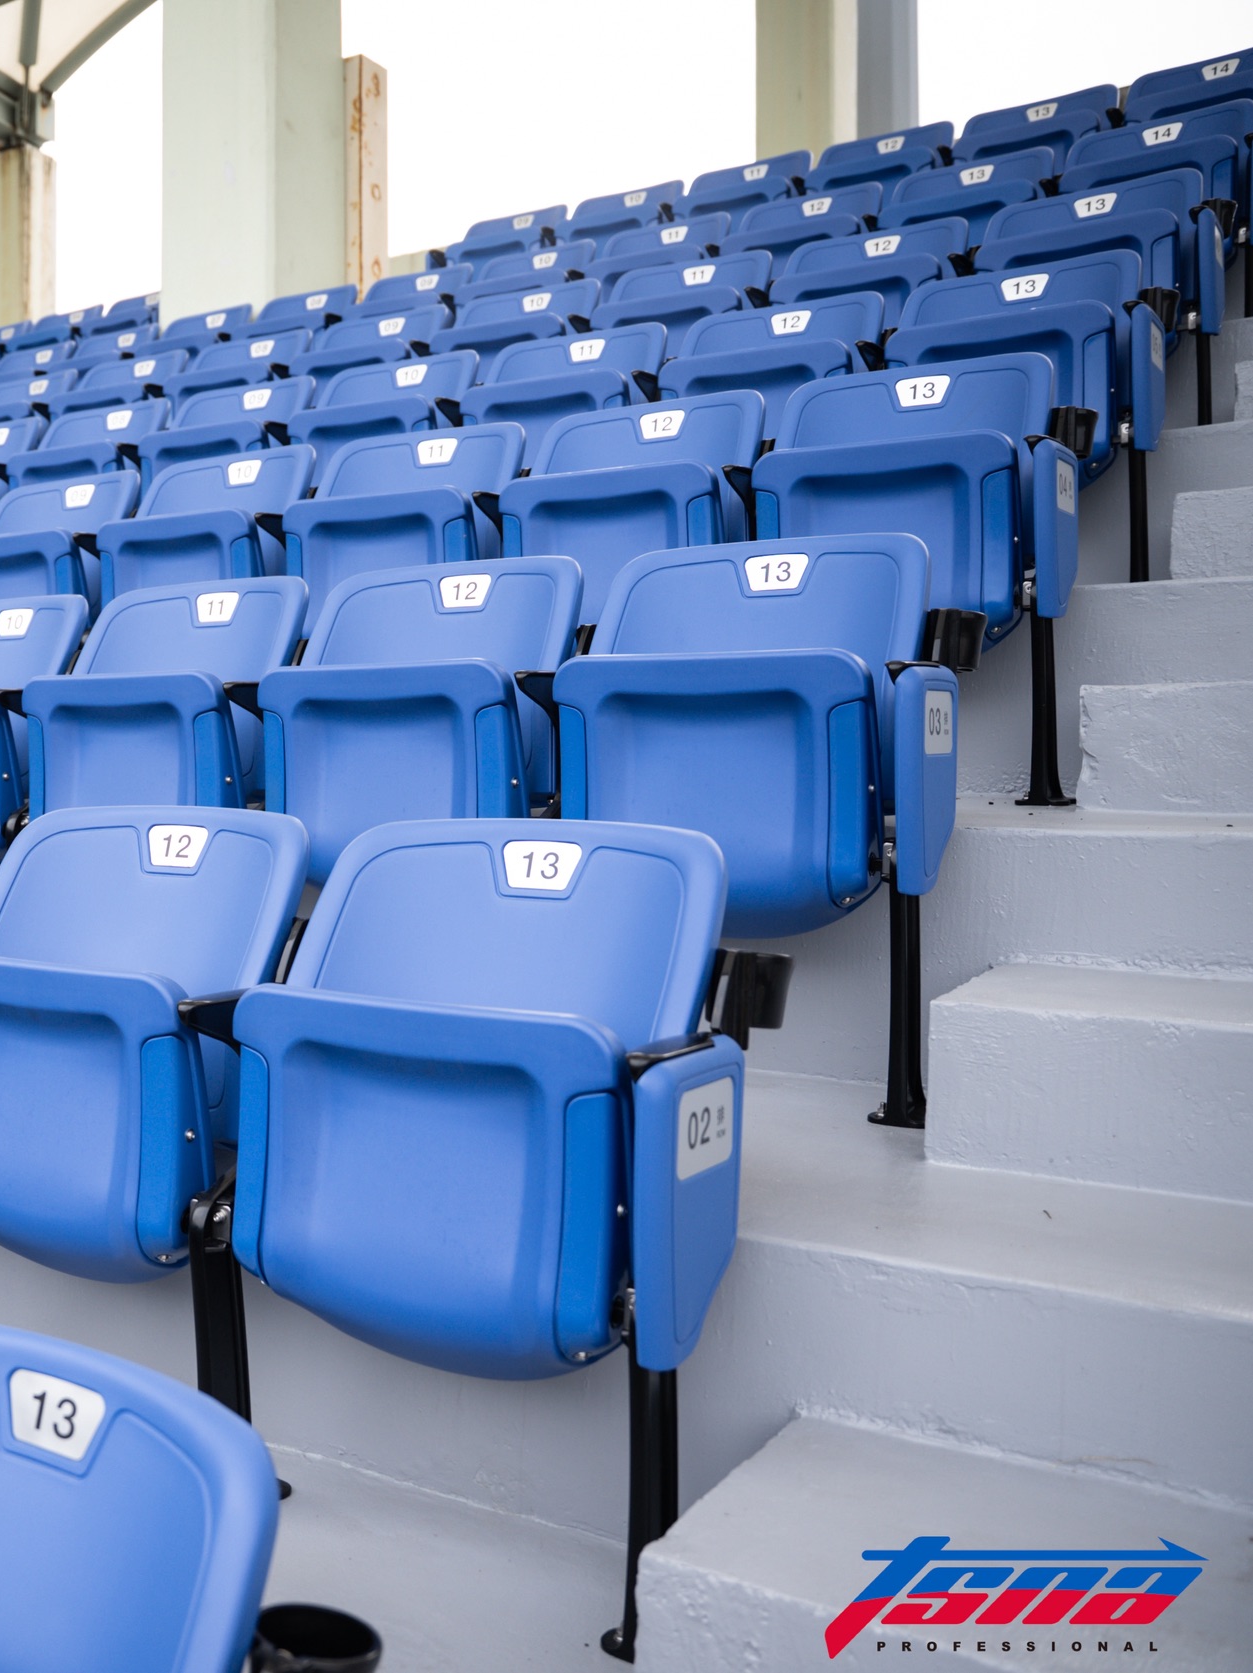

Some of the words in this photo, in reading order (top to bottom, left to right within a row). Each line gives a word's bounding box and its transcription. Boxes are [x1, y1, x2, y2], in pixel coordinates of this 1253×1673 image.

[1211, 63, 1229, 76] 14
[1035, 106, 1050, 117] 13
[1153, 127, 1171, 141] 14
[884, 139, 898, 149] 12
[750, 169, 760, 177] 11
[969, 169, 985, 181] 13
[630, 195, 641, 203] 10
[1085, 198, 1106, 212] 13
[810, 201, 824, 212] 12
[517, 217, 530, 226] 09
[668, 230, 679, 240] 11
[875, 240, 891, 252] 12
[539, 255, 551, 265] 10
[692, 270, 705, 280] 11
[420, 277, 433, 287] 09
[1013, 279, 1036, 295] 13
[530, 297, 544, 307] 10
[384, 321, 399, 332] 09
[782, 315, 801, 329] 12
[580, 344, 593, 356] 11
[405, 369, 419, 380] 10
[909, 382, 935, 400] 13
[248, 393, 265, 405] 09
[652, 416, 673, 432] 12
[429, 445, 443, 458] 11
[237, 465, 252, 478] 10
[1059, 473, 1067, 496] 04
[71, 489, 87, 502] 09
[760, 561, 791, 583] 13
[453, 581, 478, 601] 12
[208, 599, 224, 616] 11
[8, 615, 23, 630] 10
[929, 707, 941, 736] 03
[163, 834, 192, 859] 12
[522, 851, 559, 880] 13
[688, 1106, 711, 1150] 02
[33, 1391, 77, 1440] 13
